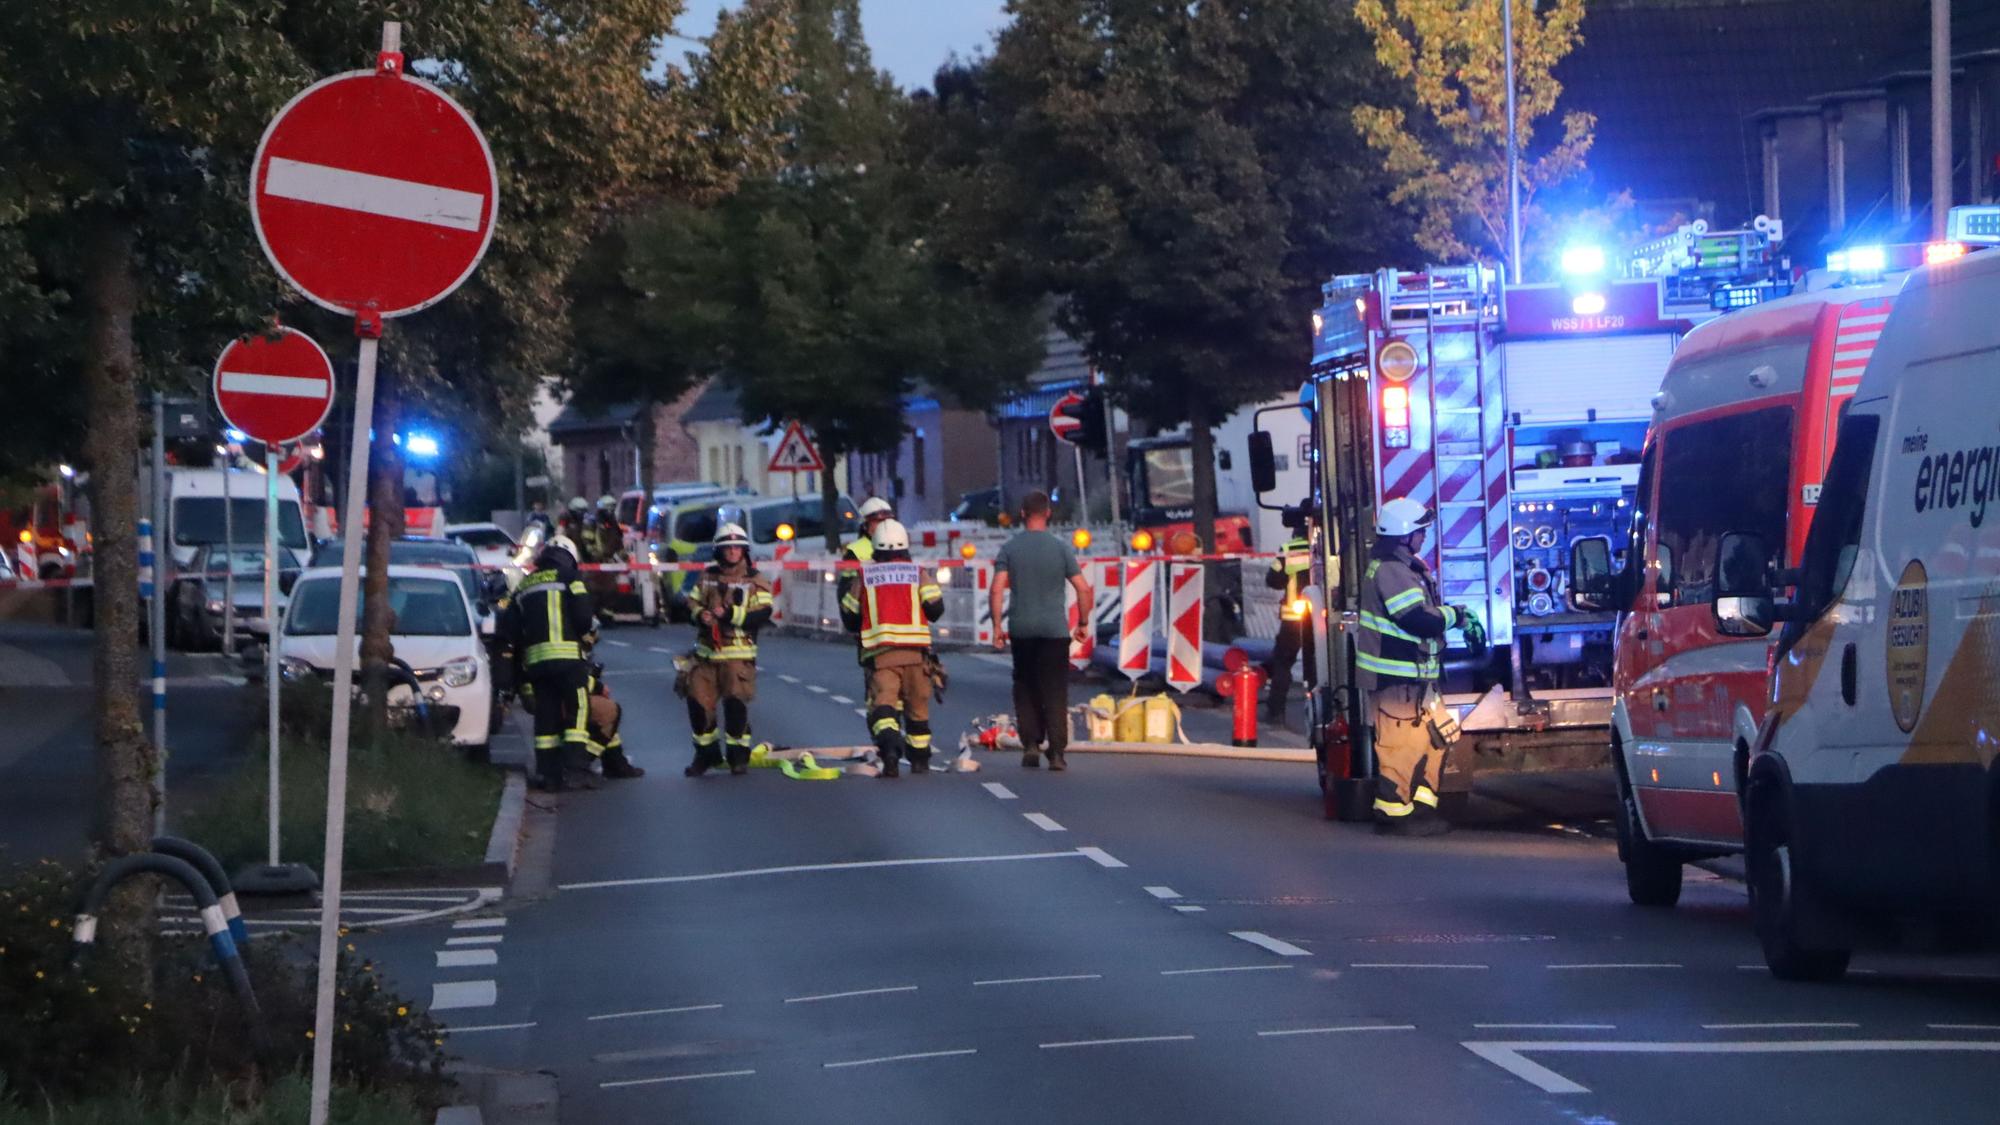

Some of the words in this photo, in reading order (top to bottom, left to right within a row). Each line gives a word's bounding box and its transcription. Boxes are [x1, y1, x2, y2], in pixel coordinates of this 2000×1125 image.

[1551, 318, 1577, 331] WSS
[1597, 315, 1624, 328] LF20
[1902, 426, 1928, 454] meine
[1914, 424, 2000, 529] energi
[867, 575, 886, 585] WSS
[895, 574, 904, 582] LF
[907, 574, 917, 583] 20
[1896, 588, 1923, 617] AZUBI
[1892, 624, 1923, 646] GESUCHT
